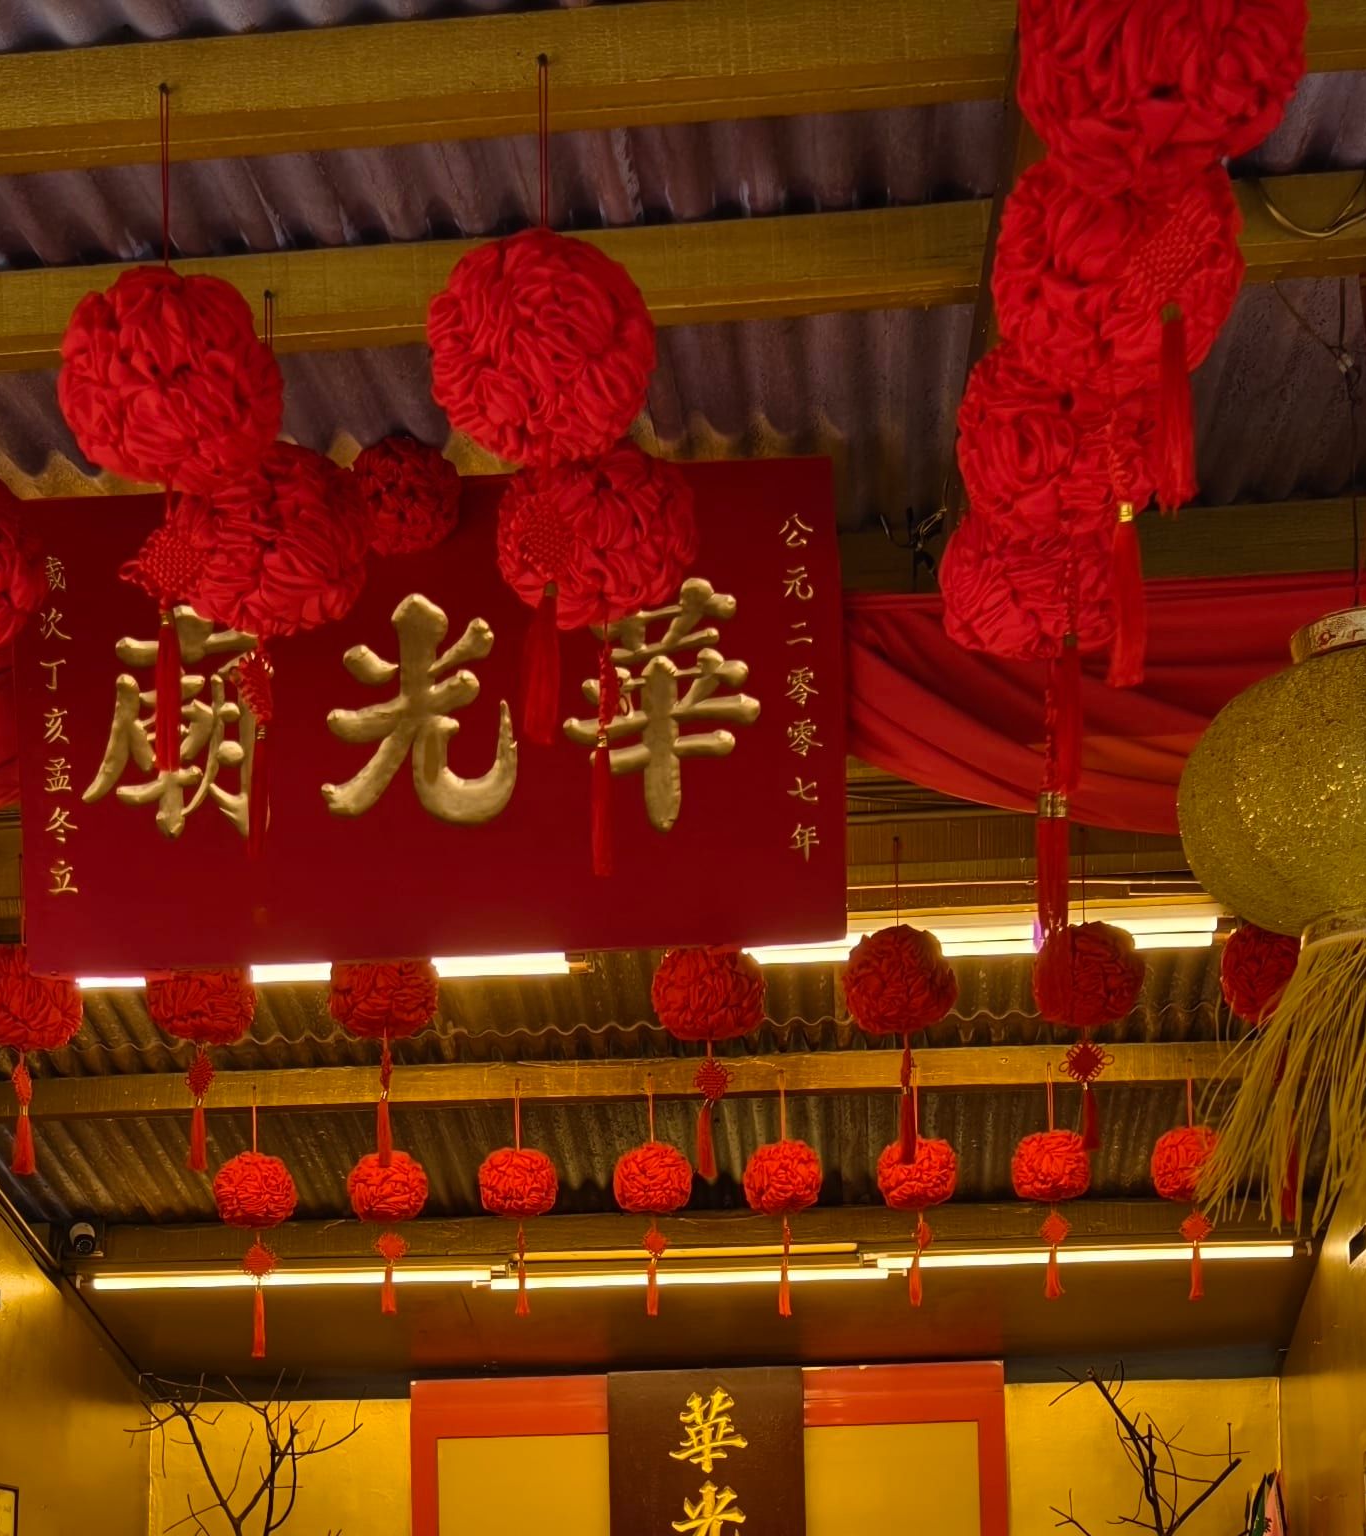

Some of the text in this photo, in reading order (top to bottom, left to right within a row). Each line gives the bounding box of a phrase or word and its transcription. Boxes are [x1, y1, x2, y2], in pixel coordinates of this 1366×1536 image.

[779, 512, 824, 863] 公元二零零七年
